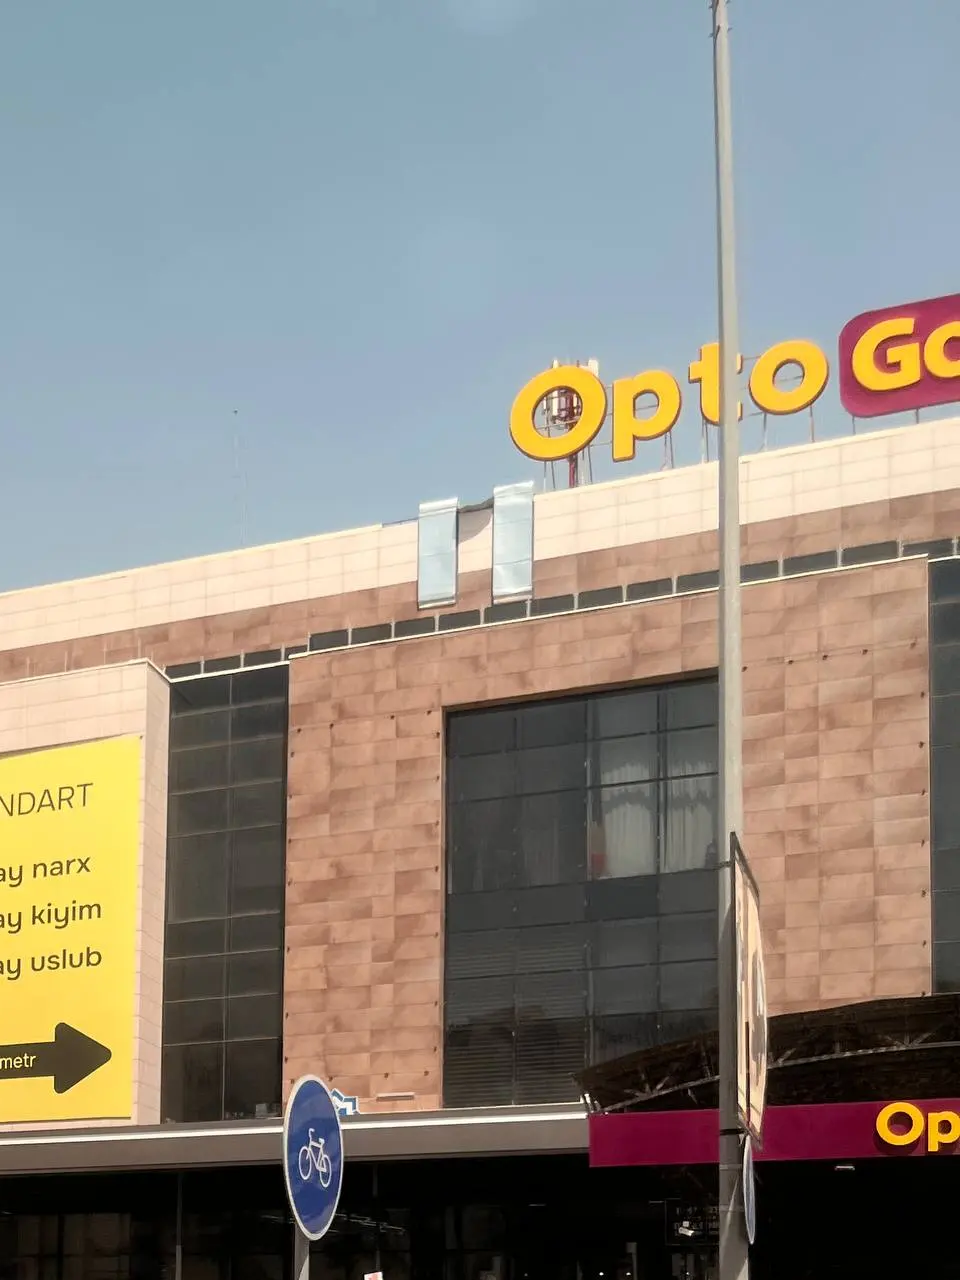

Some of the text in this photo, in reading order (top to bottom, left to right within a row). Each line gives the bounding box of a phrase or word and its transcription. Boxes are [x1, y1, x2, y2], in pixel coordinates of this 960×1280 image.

[509, 339, 830, 463] Opto
[32, 857, 92, 879] narx
[31, 899, 102, 929] kiyim
[31, 946, 103, 972] uslub
[0, 1052, 36, 1070] metr
